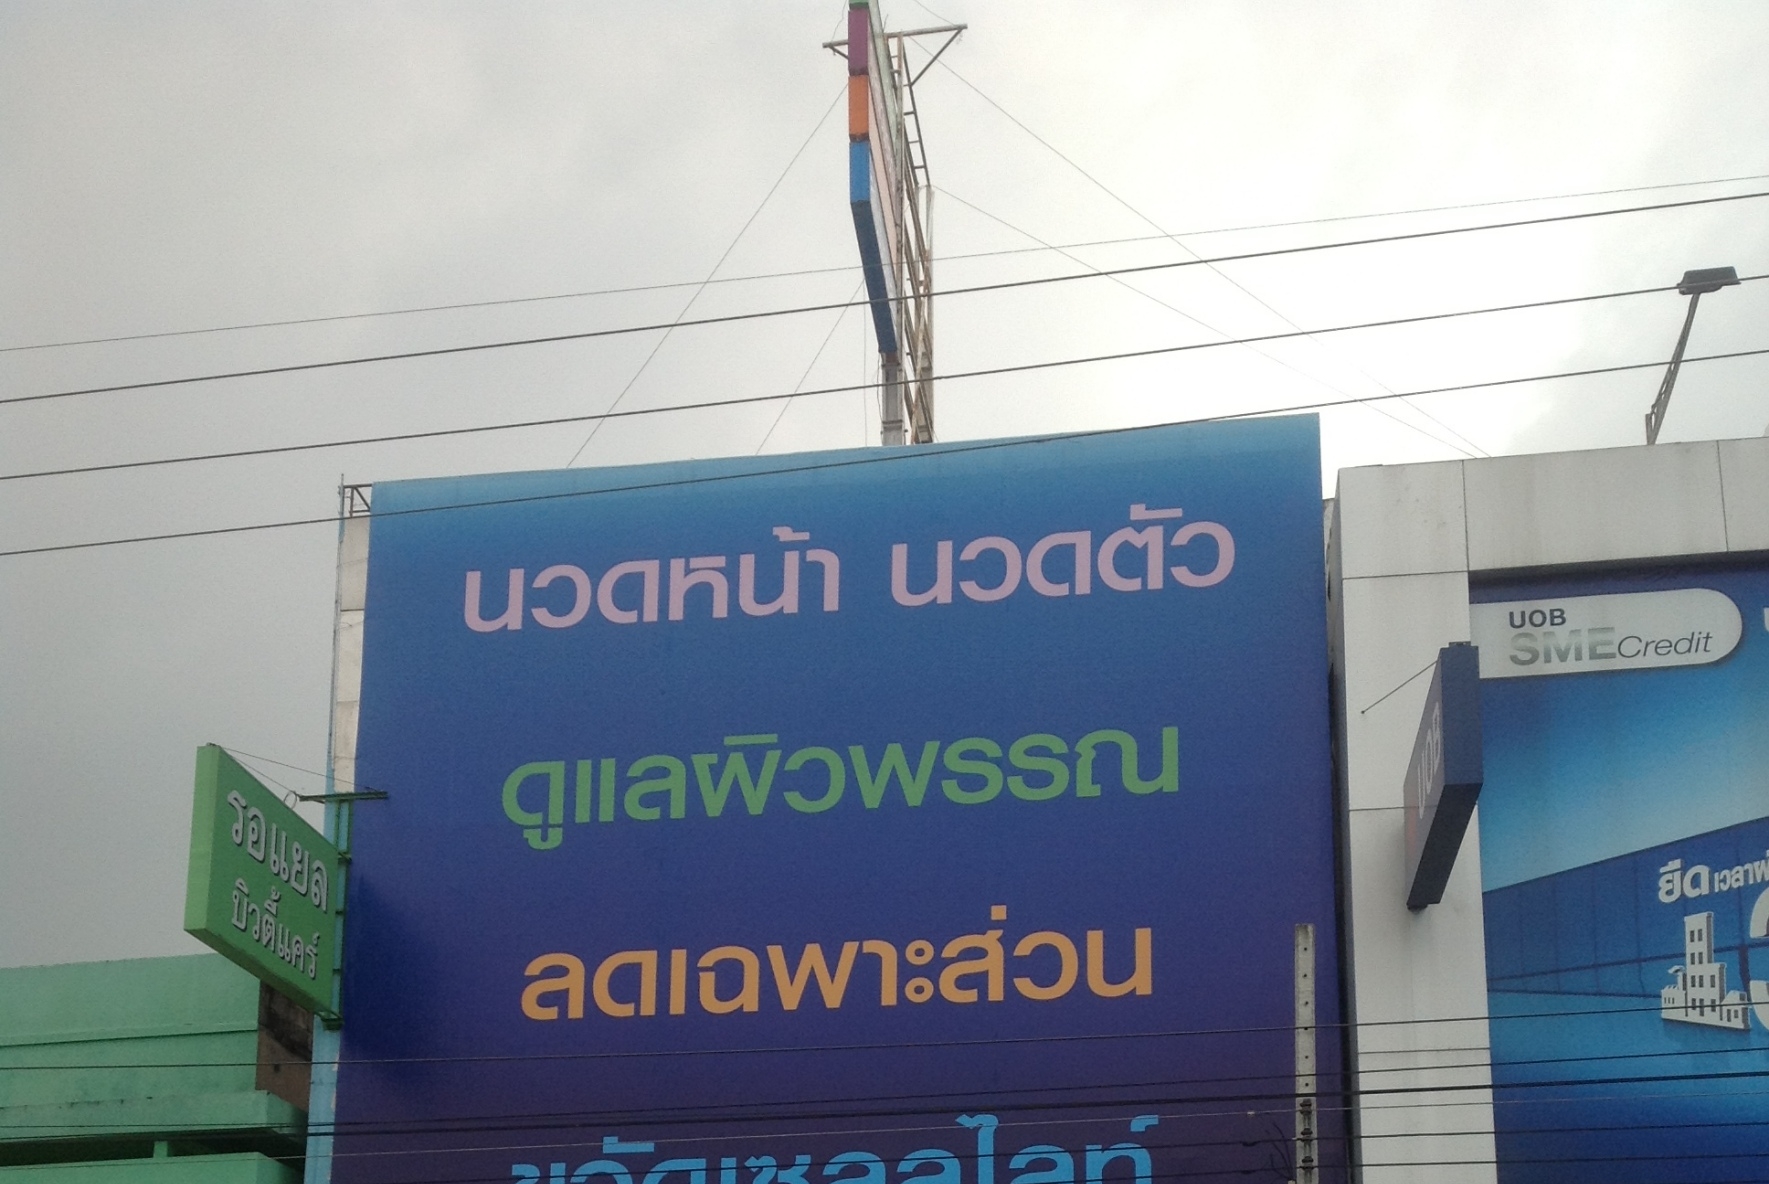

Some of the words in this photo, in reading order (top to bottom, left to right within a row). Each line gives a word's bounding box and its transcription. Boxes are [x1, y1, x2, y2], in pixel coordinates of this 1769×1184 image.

[461, 526, 841, 634] นวดหน้า
[889, 503, 1236, 606] นวดตัว
[1509, 608, 1567, 629] UOB
[502, 726, 1180, 850] ดูแลผิวพรรณ
[520, 904, 1154, 1022] ลดเฉพาะส่วน
